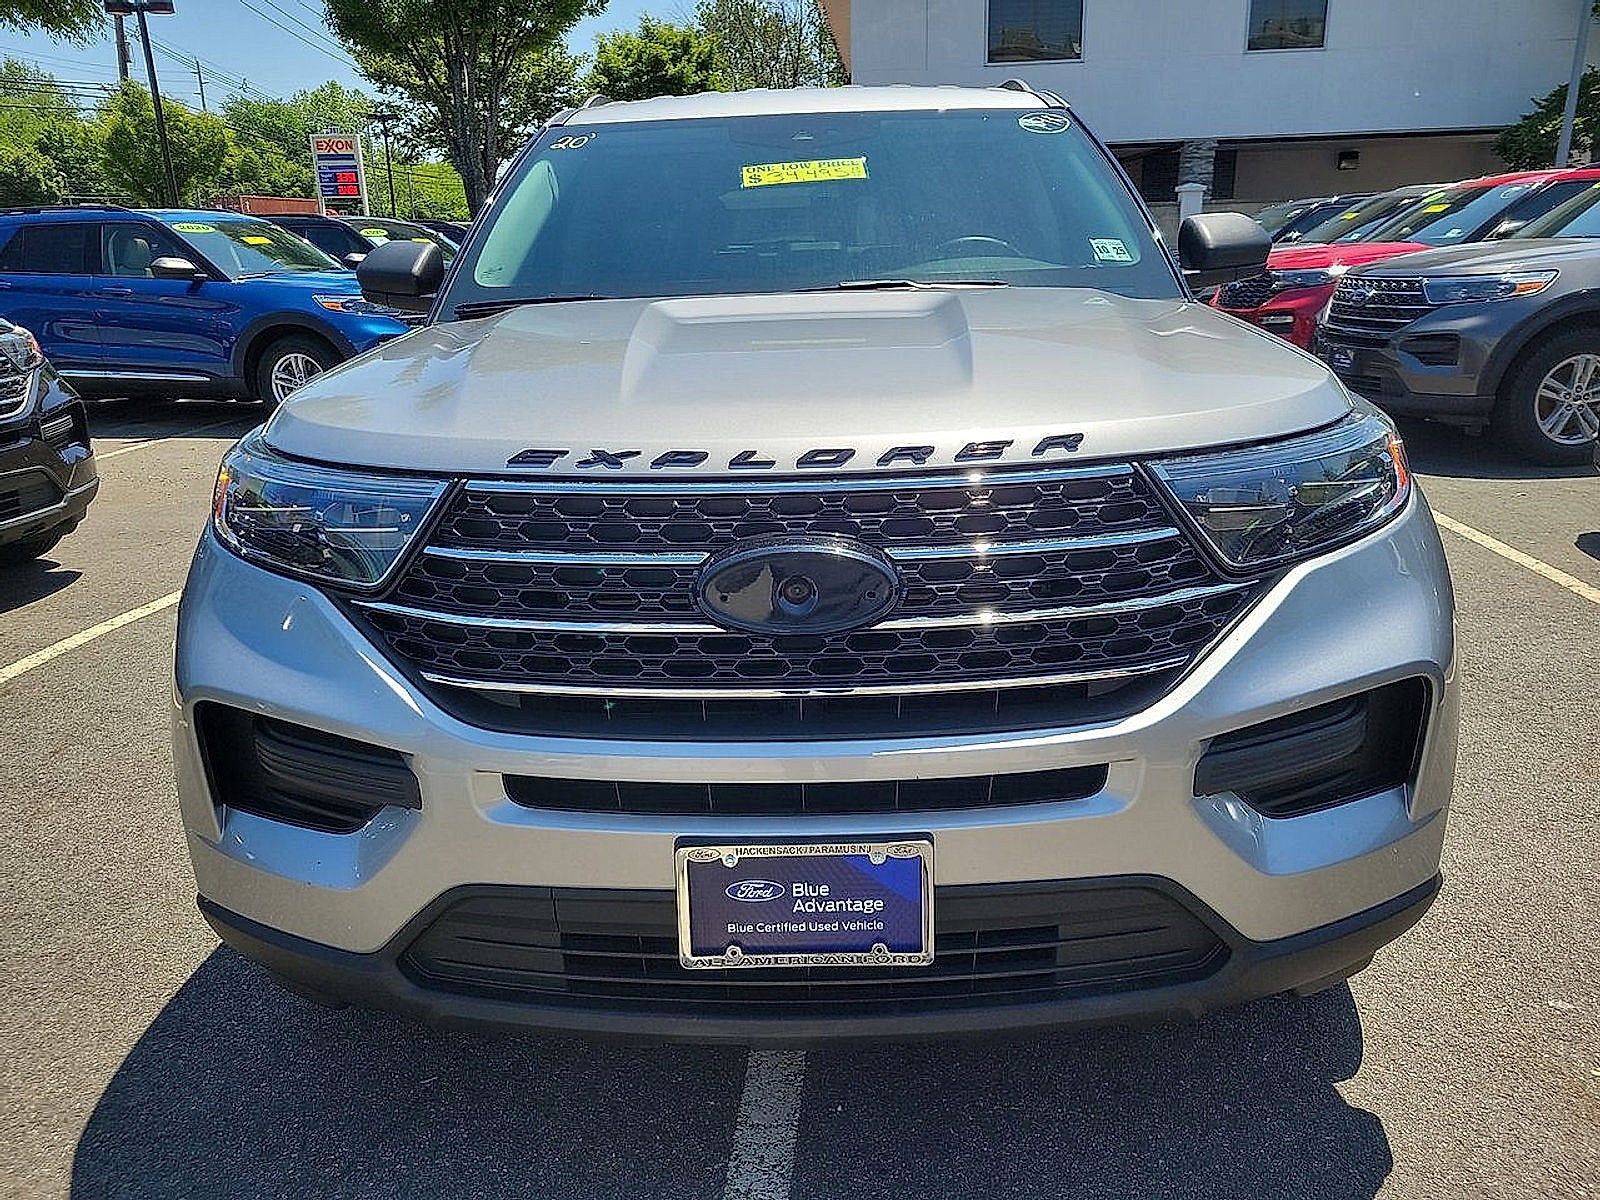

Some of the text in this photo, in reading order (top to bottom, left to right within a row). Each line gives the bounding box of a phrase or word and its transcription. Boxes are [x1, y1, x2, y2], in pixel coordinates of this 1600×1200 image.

[316, 139, 354, 153] EXXON
[746, 160, 860, 174] ONE LOW PRICE
[1096, 245, 1126, 255] 10 25
[506, 432, 1085, 469] EXPLORER
[737, 883, 774, 898] Ford
[792, 883, 830, 898] Blue
[792, 899, 885, 914] Advantage
[728, 919, 884, 933] Blue Certified Used Vehicle
[739, 954, 855, 966] AMERICAN
